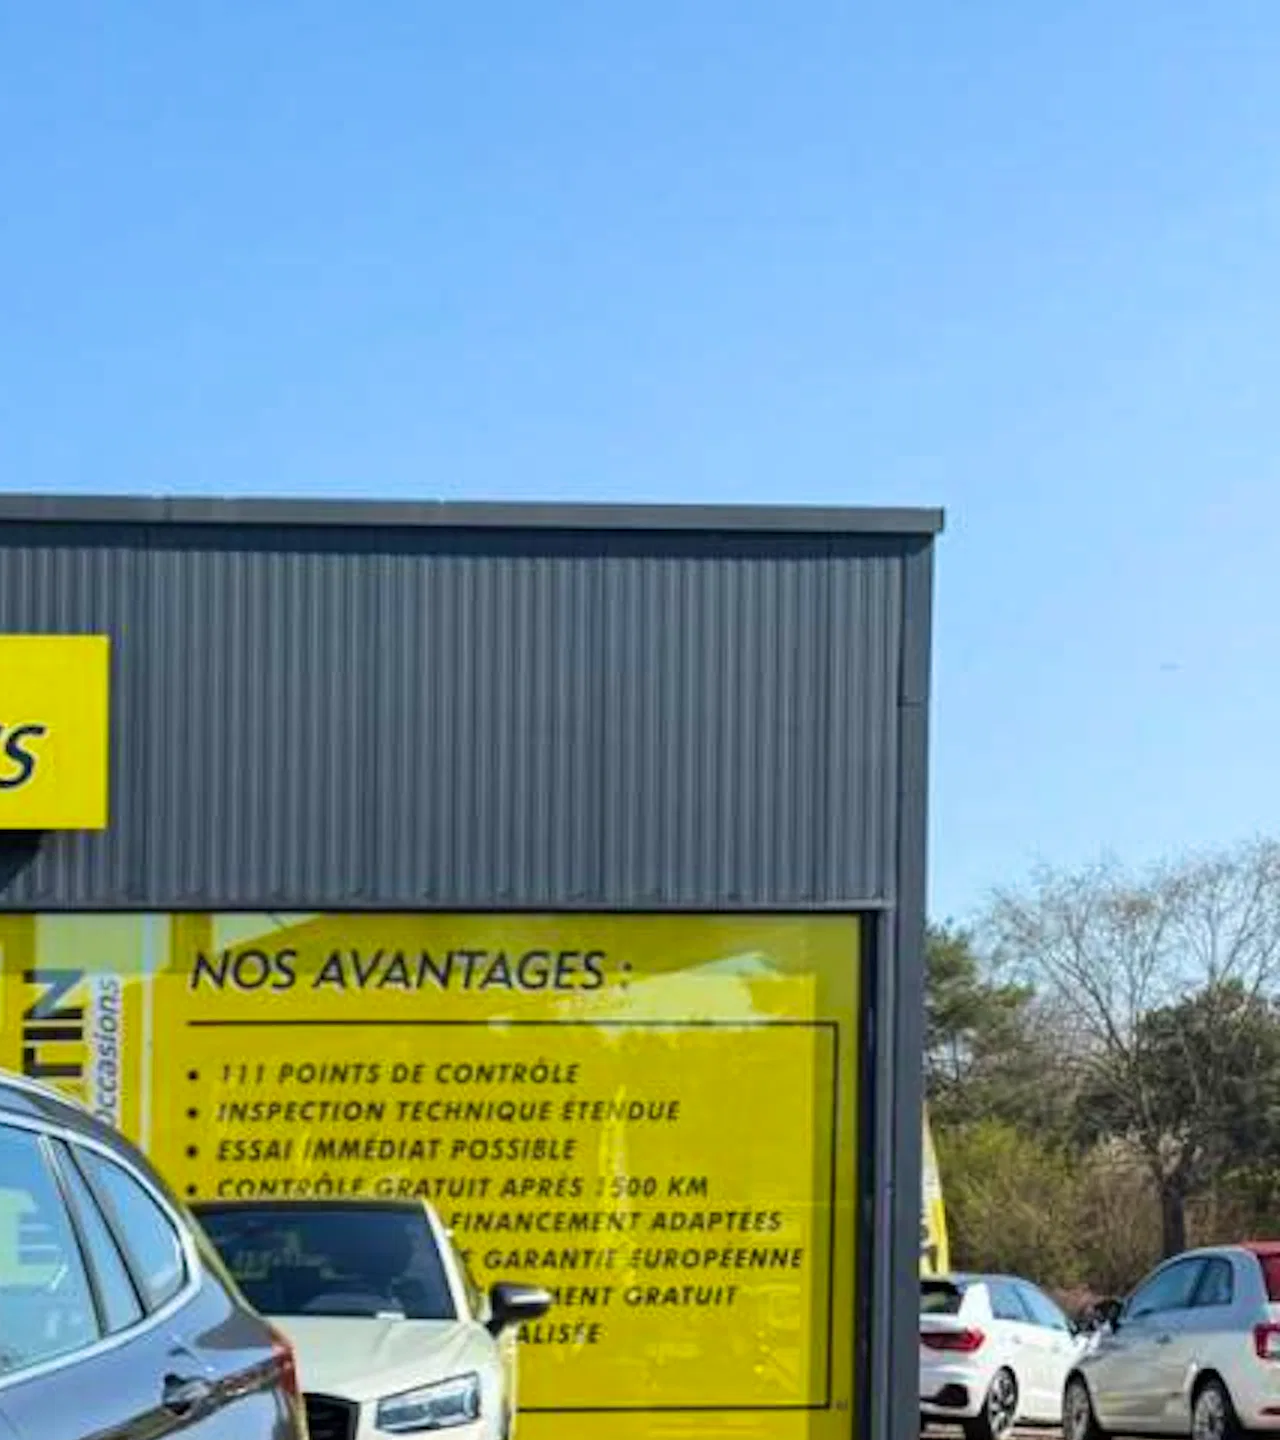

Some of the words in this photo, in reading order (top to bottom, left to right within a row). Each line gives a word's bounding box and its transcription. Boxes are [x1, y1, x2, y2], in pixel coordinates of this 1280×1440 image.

[190, 948, 298, 991] NOS
[312, 949, 607, 991] AVANTAGES
[223, 1062, 265, 1084] 111
[277, 1062, 381, 1084] POINTS
[391, 1062, 426, 1084] DE
[434, 1056, 581, 1084] CONTRÔLE
[217, 1101, 385, 1122] INSPECTION
[397, 1100, 553, 1122] TECHNIQUE
[561, 1095, 681, 1121] ÉTENDUE
[216, 1138, 294, 1161] ESSAI
[303, 1134, 442, 1160] IMMÉDIAT
[450, 1139, 578, 1161] POSSIBLE
[217, 1173, 365, 1198] CONTRÔLE
[373, 1177, 493, 1199] GRATUIT
[668, 1176, 709, 1197] KM
[450, 1212, 643, 1232] FINANCEMENT
[649, 1206, 784, 1232] ADAPTÉES
[483, 1249, 621, 1270] GARANTIE
[628, 1243, 806, 1269] EUROPÉENNE
[623, 1285, 741, 1307] GRATUIT
